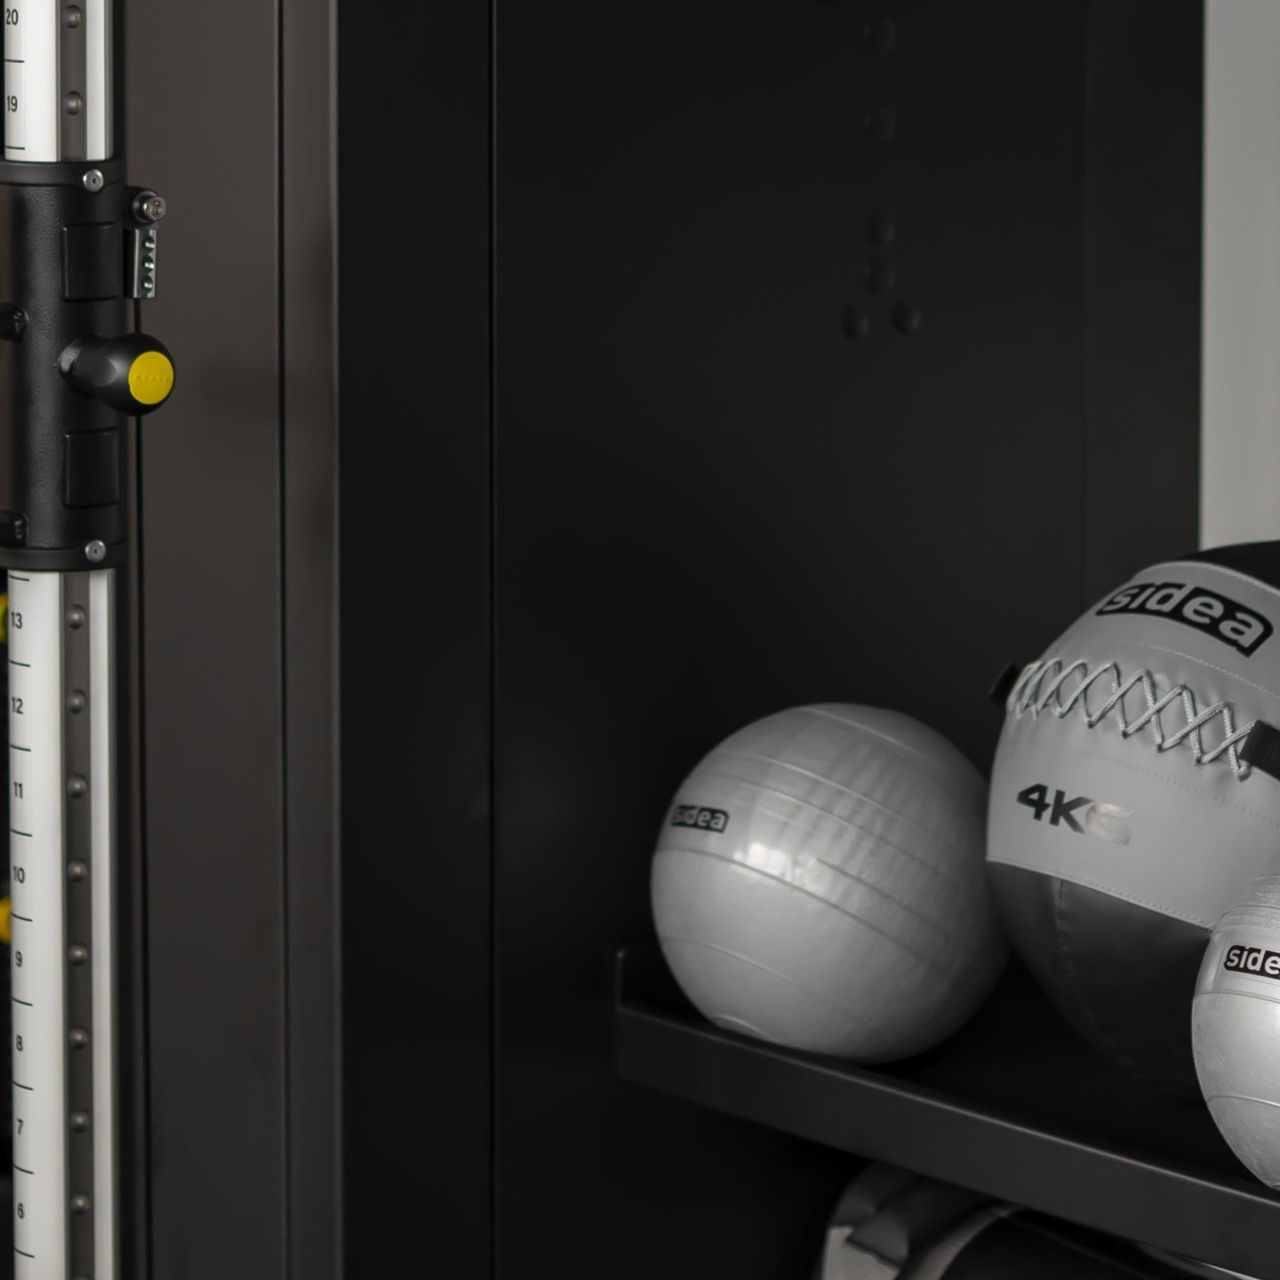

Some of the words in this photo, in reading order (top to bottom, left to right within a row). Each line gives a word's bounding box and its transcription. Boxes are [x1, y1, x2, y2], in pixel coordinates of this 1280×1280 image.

[6, 8, 19, 25] 20
[7, 95, 18, 112] 19
[11, 612, 23, 629] 13
[1099, 582, 1267, 652] sidea
[11, 697, 24, 714] 12
[13, 781, 23, 799] 11
[12, 866, 25, 883] 10
[15, 950, 23, 967] 9
[16, 1035, 23, 1051] 8
[16, 1118, 23, 1135] 7
[17, 1203, 24, 1219] 6
